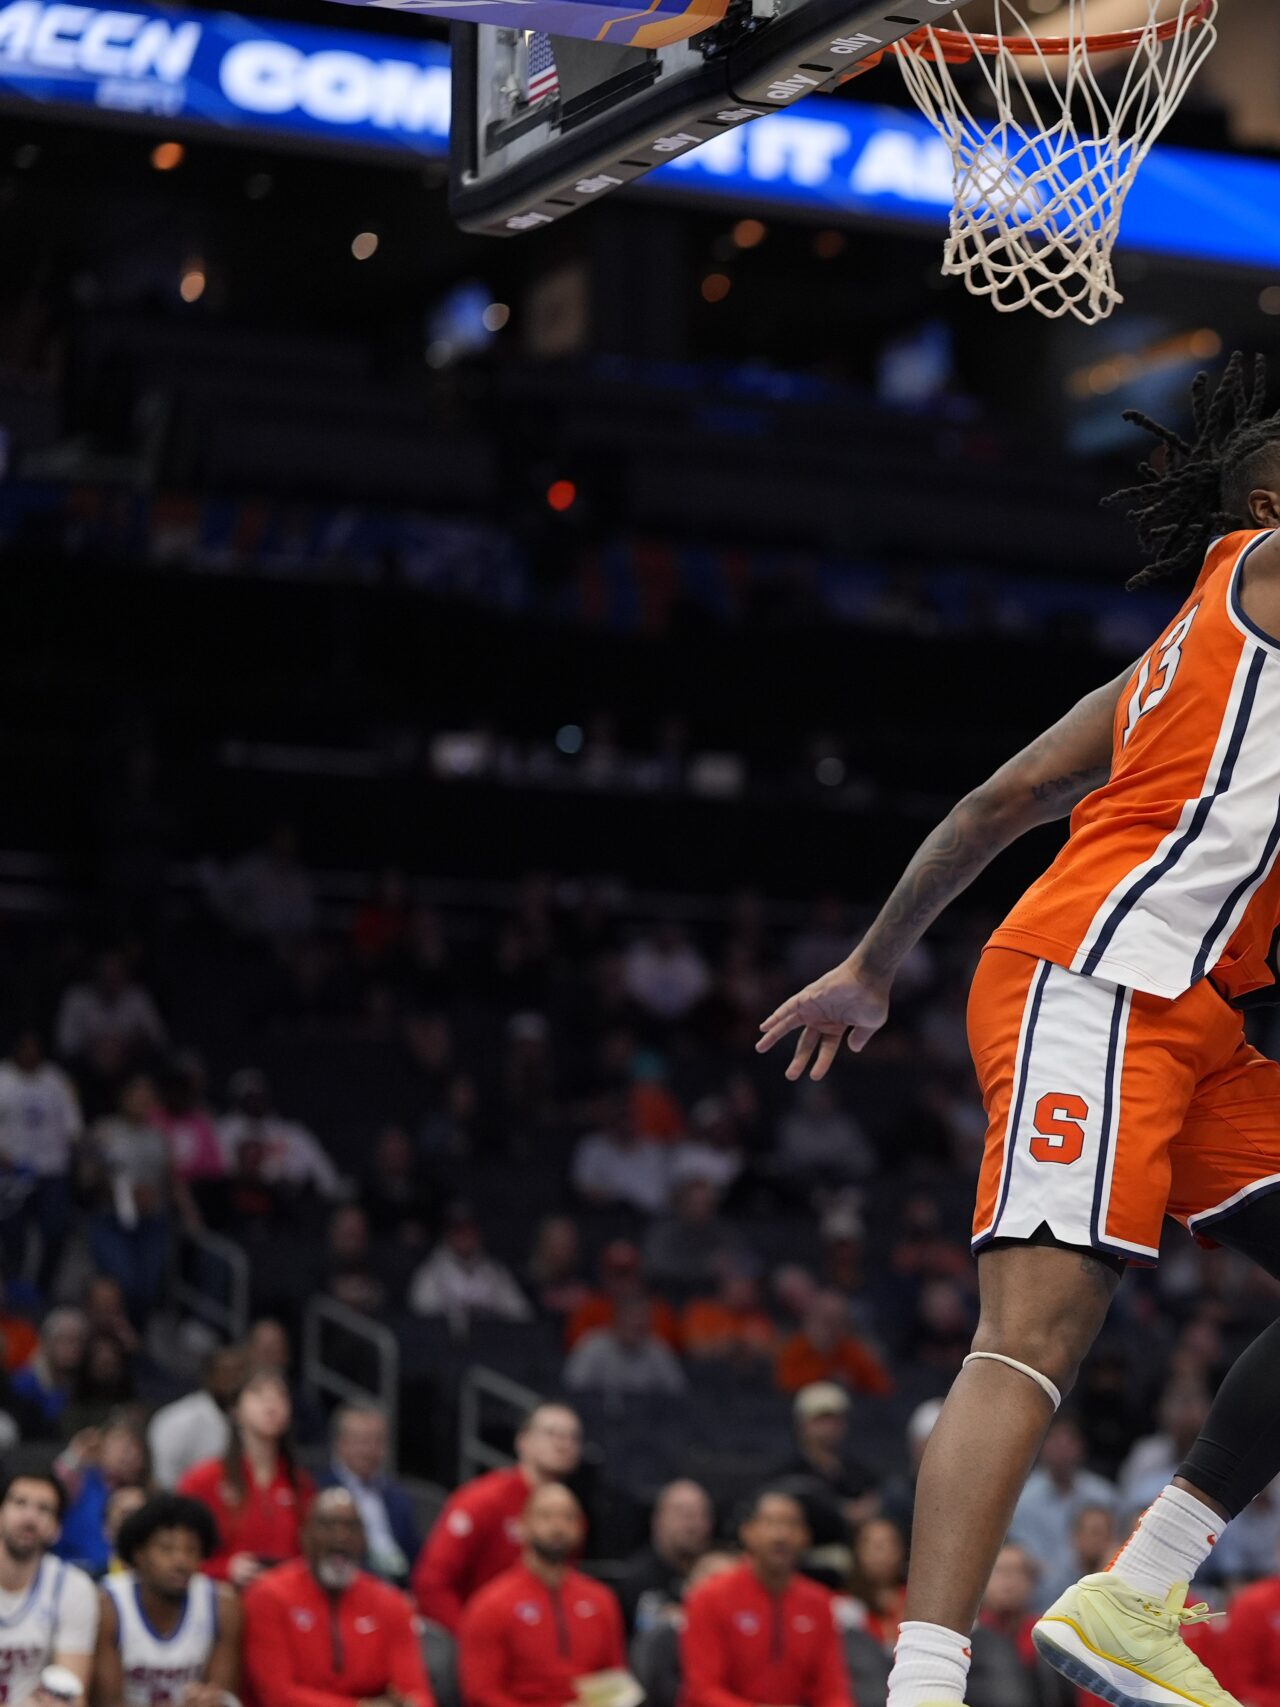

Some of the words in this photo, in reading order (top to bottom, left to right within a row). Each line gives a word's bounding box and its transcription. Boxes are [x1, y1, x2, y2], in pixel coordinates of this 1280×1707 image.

[830, 33, 882, 54] ally
[219, 38, 452, 137] COM
[767, 73, 819, 99] ally
[1122, 603, 1199, 750] 13
[1029, 1092, 1089, 1165] S
